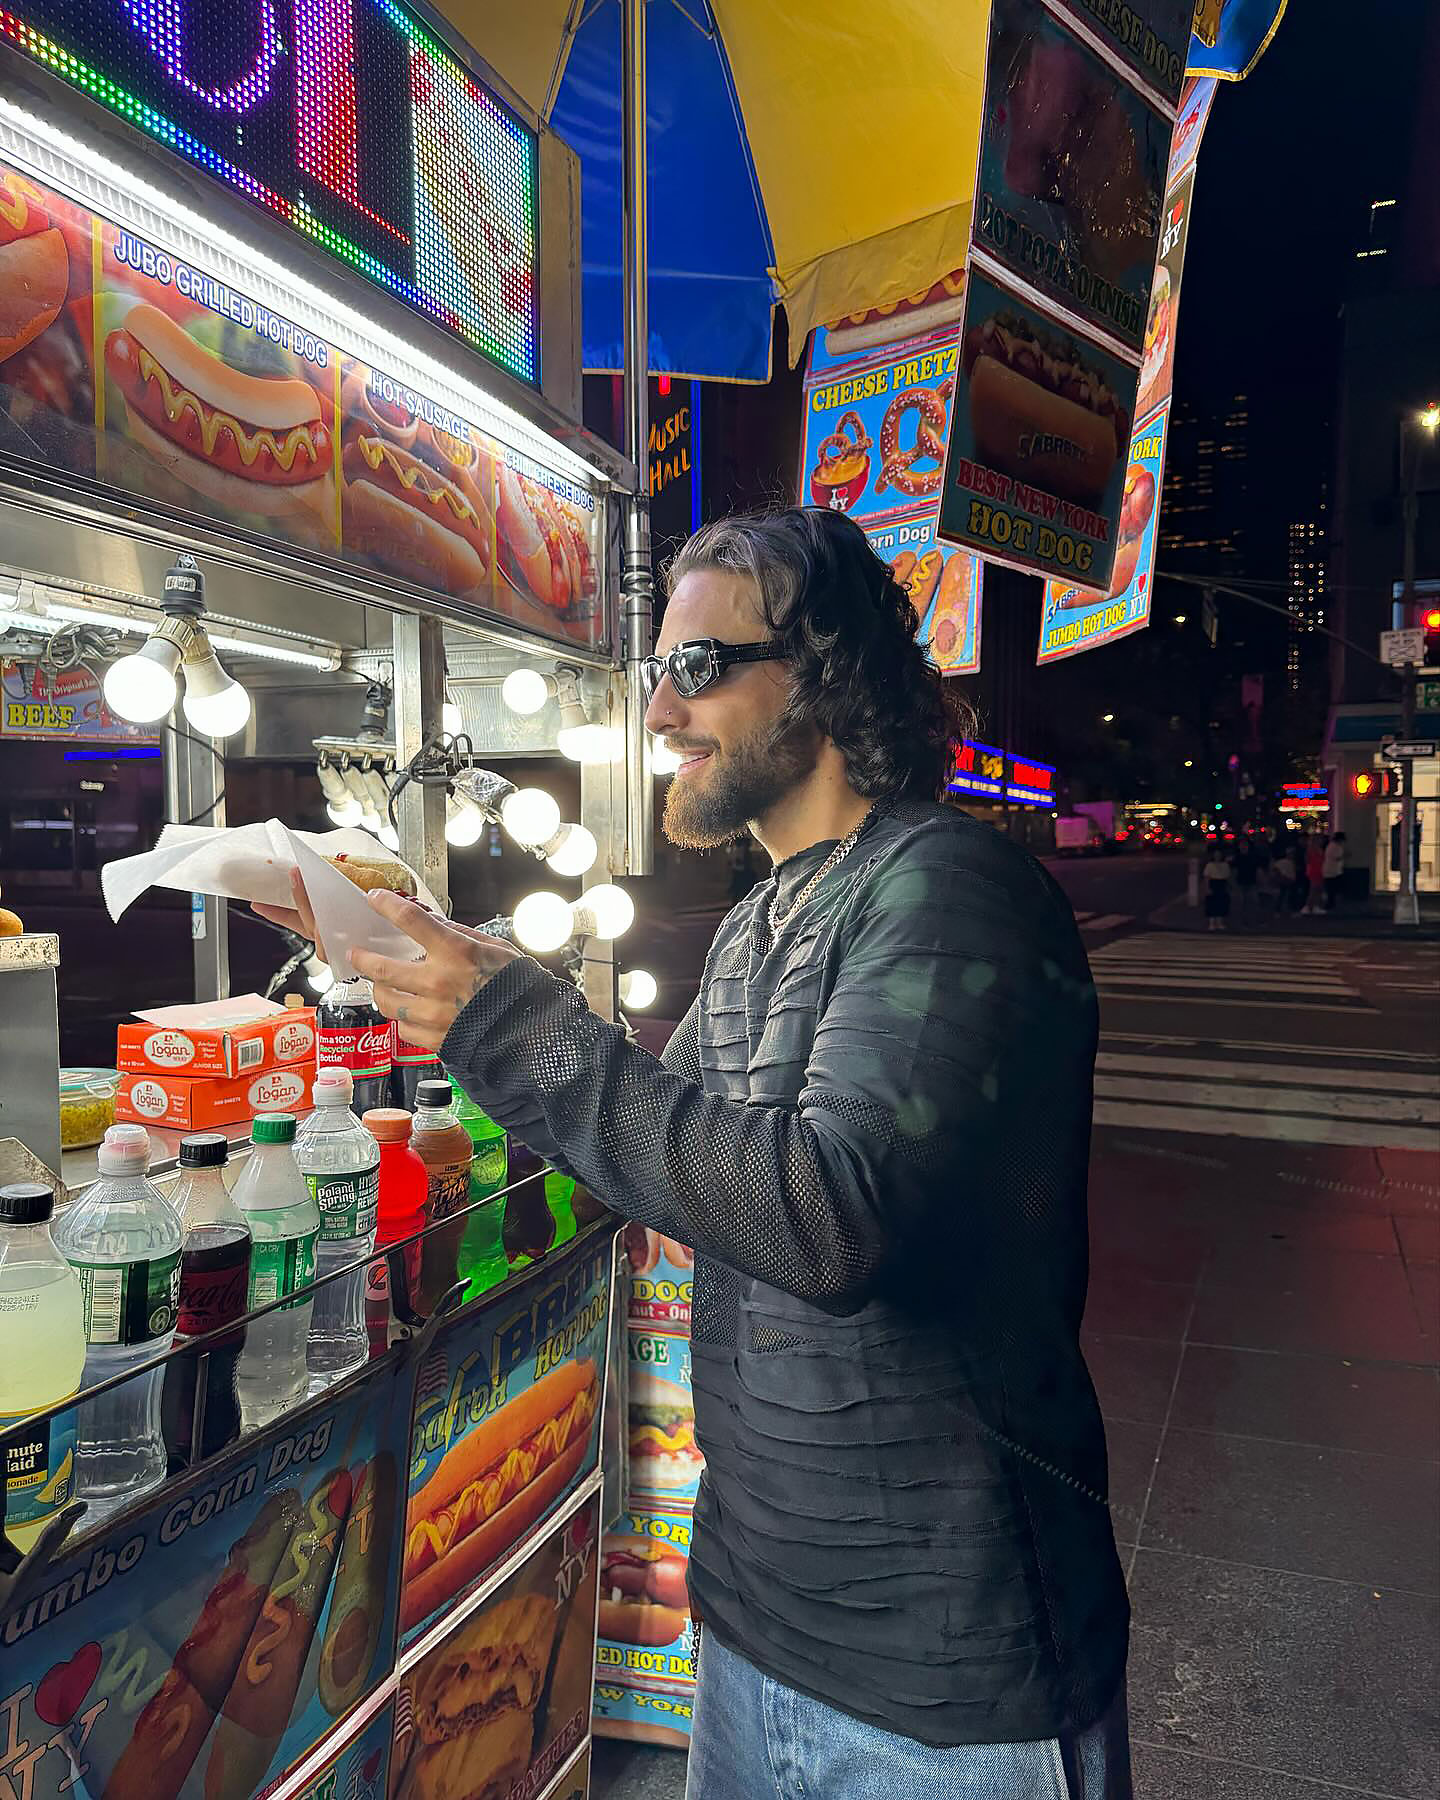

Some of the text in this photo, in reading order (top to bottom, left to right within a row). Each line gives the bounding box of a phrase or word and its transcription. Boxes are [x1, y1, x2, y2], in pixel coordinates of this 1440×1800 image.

[114, 229, 328, 369] JUBO GRILLED HOT DOG
[371, 370, 473, 444] HOT SAUSAGE
[812, 369, 889, 412] CHEESE
[534, 462, 573, 502] CHEESE
[572, 485, 595, 513] DOG
[649, 447, 691, 497] HALL
[956, 457, 1109, 543] BEST NEW YORK
[898, 525, 931, 545] Dog
[968, 500, 1032, 551] HOT
[1037, 525, 1094, 571] DOG
[1046, 618, 1081, 650] JUMBO
[1082, 609, 1105, 638] HOT
[1103, 599, 1127, 629] DOG
[8, 704, 76, 729] BEEF
[151, 1041, 193, 1058] Logan
[280, 1034, 310, 1053] Logan
[135, 1088, 165, 1108] Logan
[257, 1085, 298, 1104] Logan
[317, 1181, 355, 1201] Poland
[319, 1191, 357, 1212] Spring
[158, 1463, 259, 1547] Corn
[264, 1416, 335, 1483] Dog
[554, 1539, 594, 1610] NY
[625, 1649, 666, 1672] HOT
